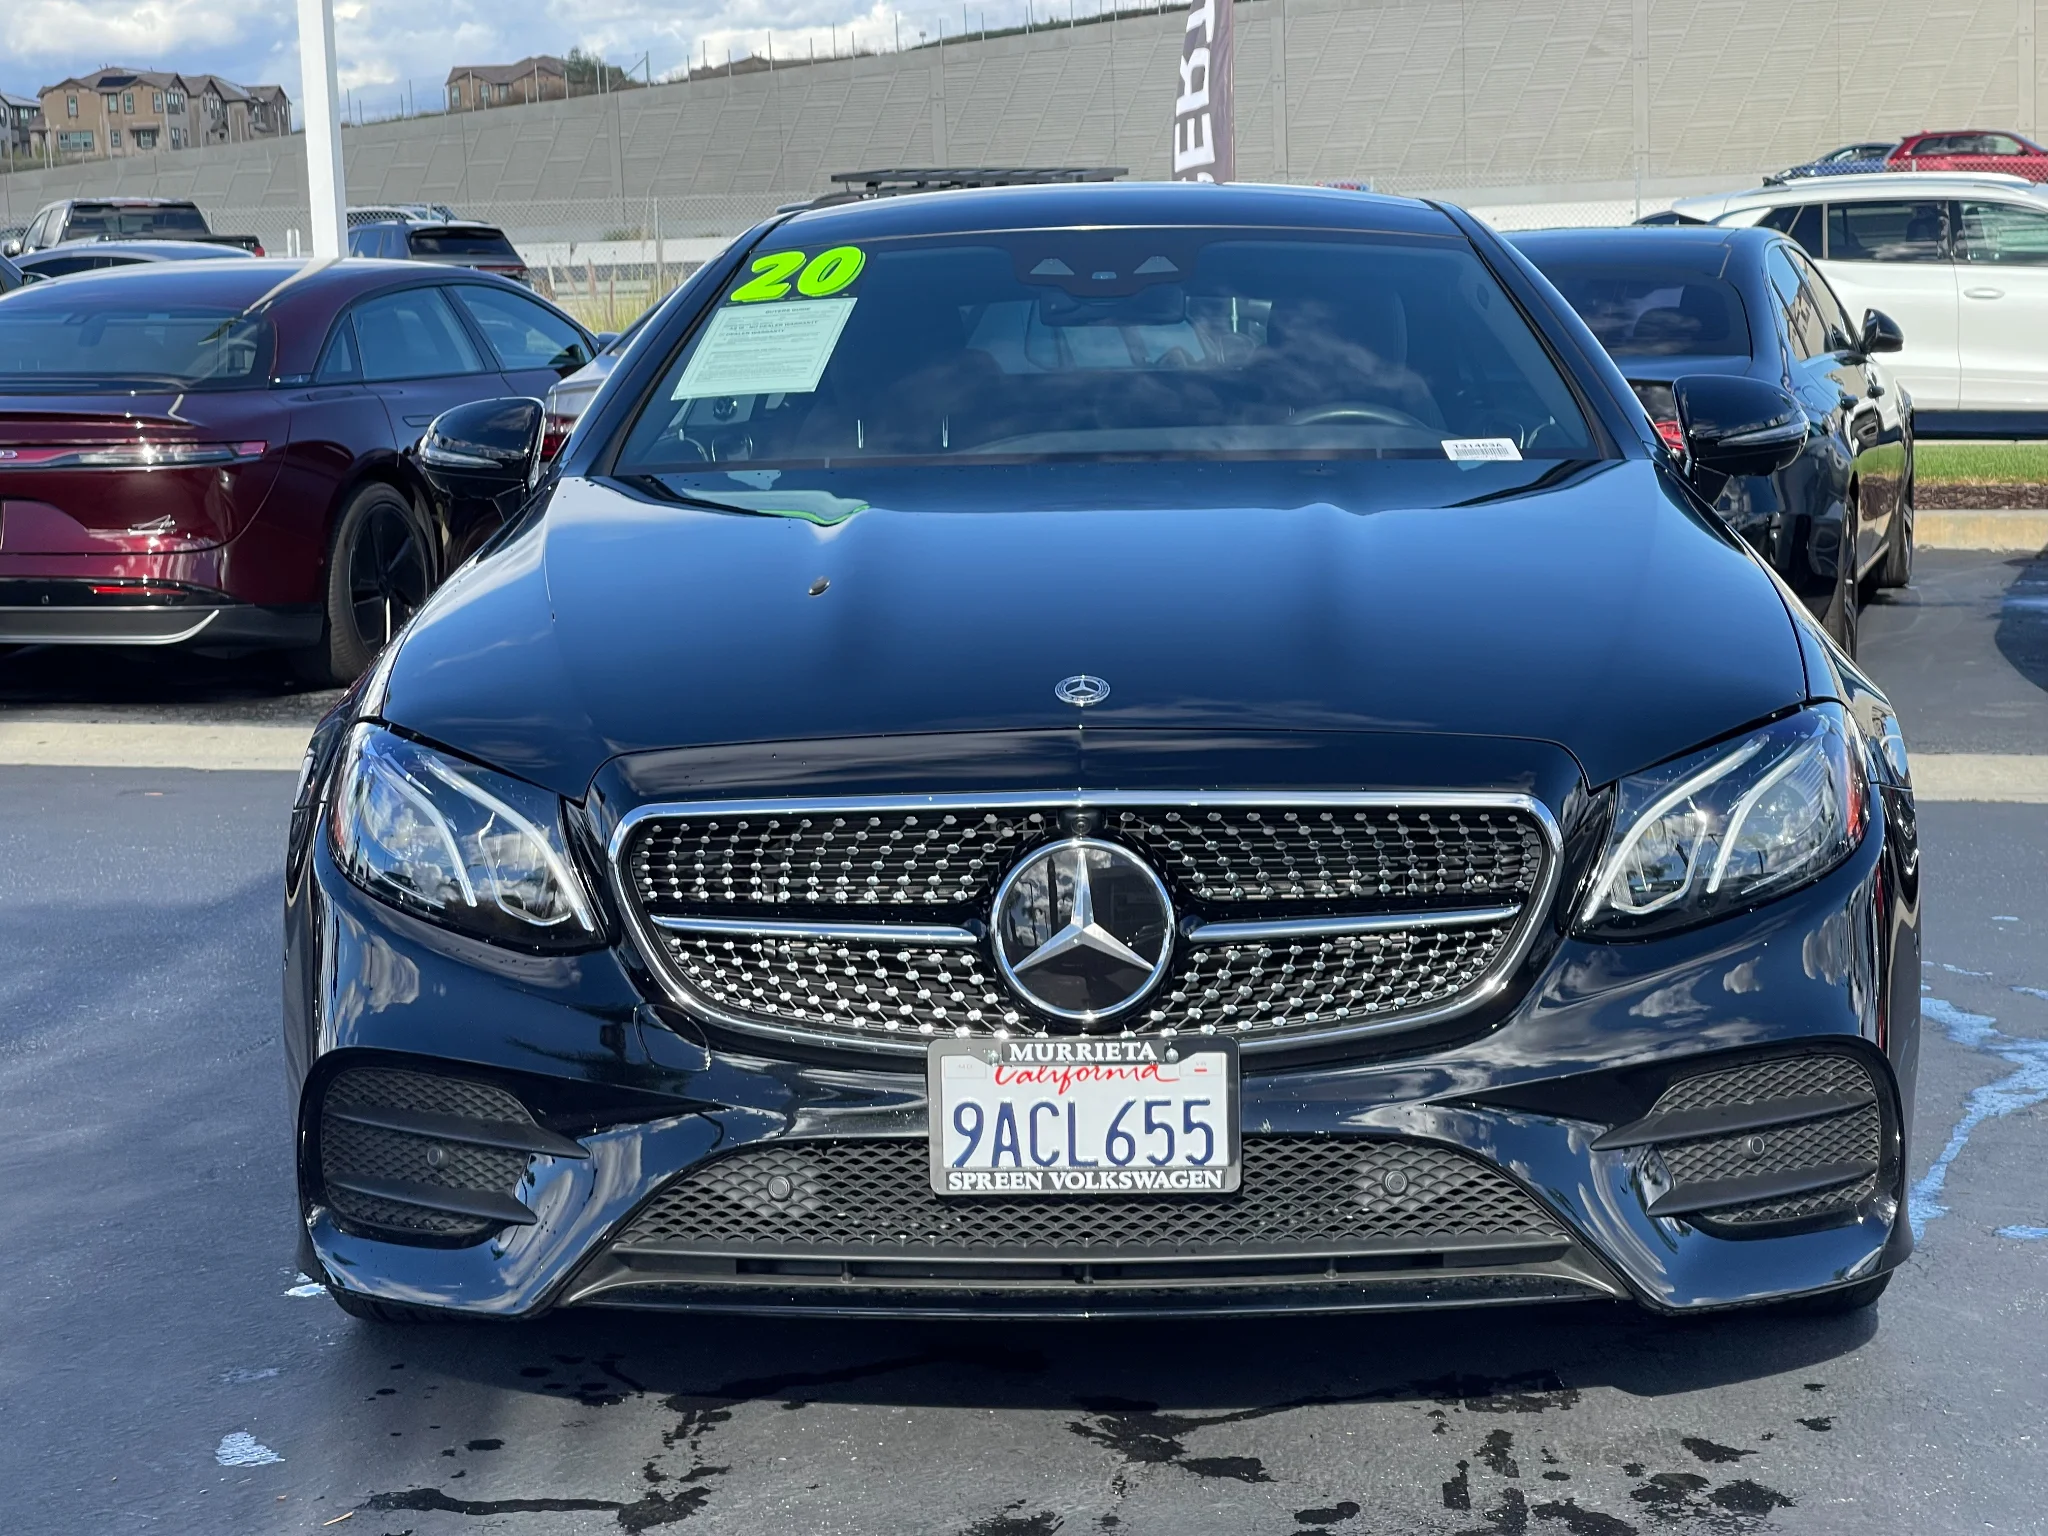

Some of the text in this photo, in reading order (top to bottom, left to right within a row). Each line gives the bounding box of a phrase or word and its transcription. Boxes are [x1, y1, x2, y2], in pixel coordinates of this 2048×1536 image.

[731, 246, 866, 302] 20
[1009, 1043, 1157, 1061] MURRIETA
[994, 1063, 1180, 1095] California
[952, 1099, 1214, 1168] 9ACL655
[949, 1170, 1223, 1190] SPREEN VOLKSWAGEN
